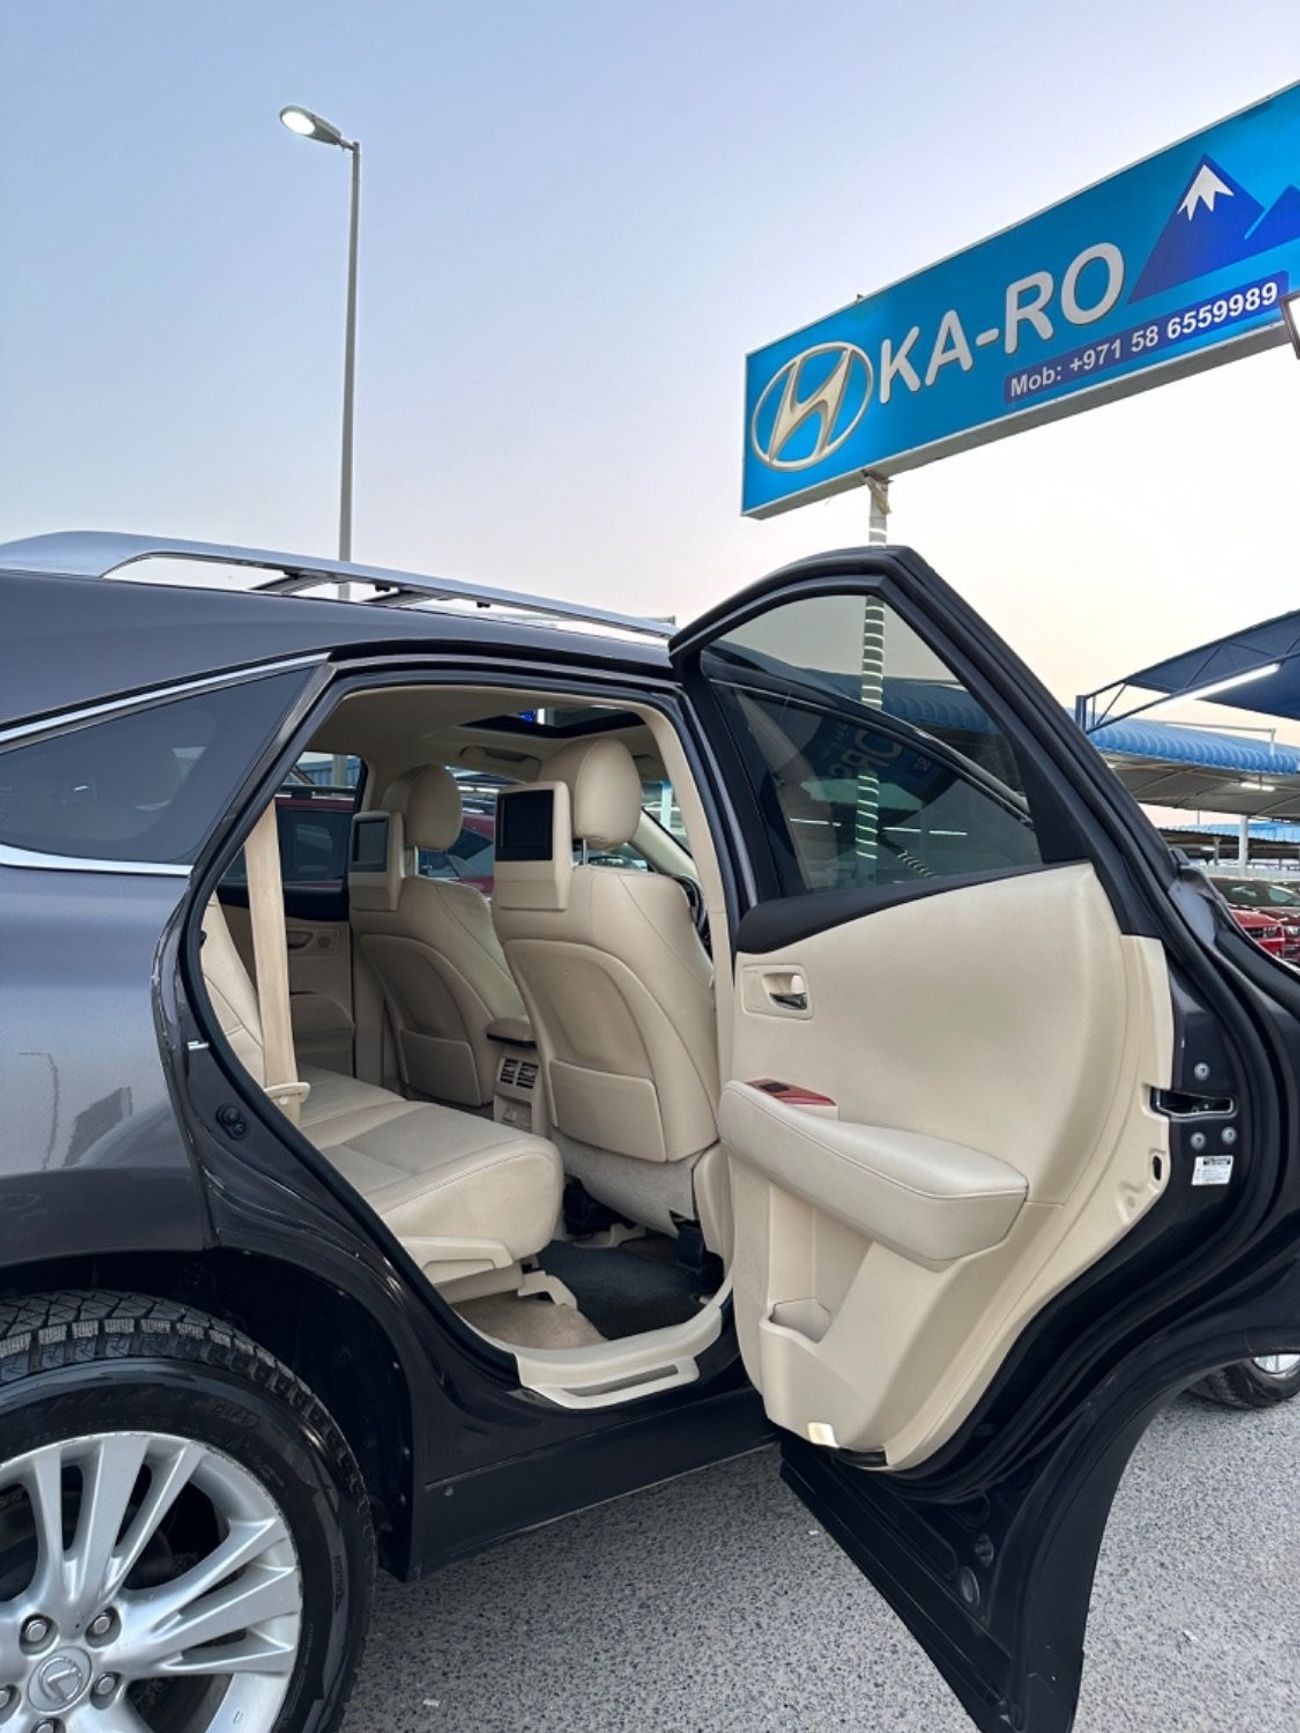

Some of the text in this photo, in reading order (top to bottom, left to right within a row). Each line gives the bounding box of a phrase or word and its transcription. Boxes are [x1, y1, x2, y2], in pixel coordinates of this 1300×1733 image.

[879, 242, 1125, 404] KA-RO
[1010, 281, 1278, 397] Mob: +971 58 6559989
